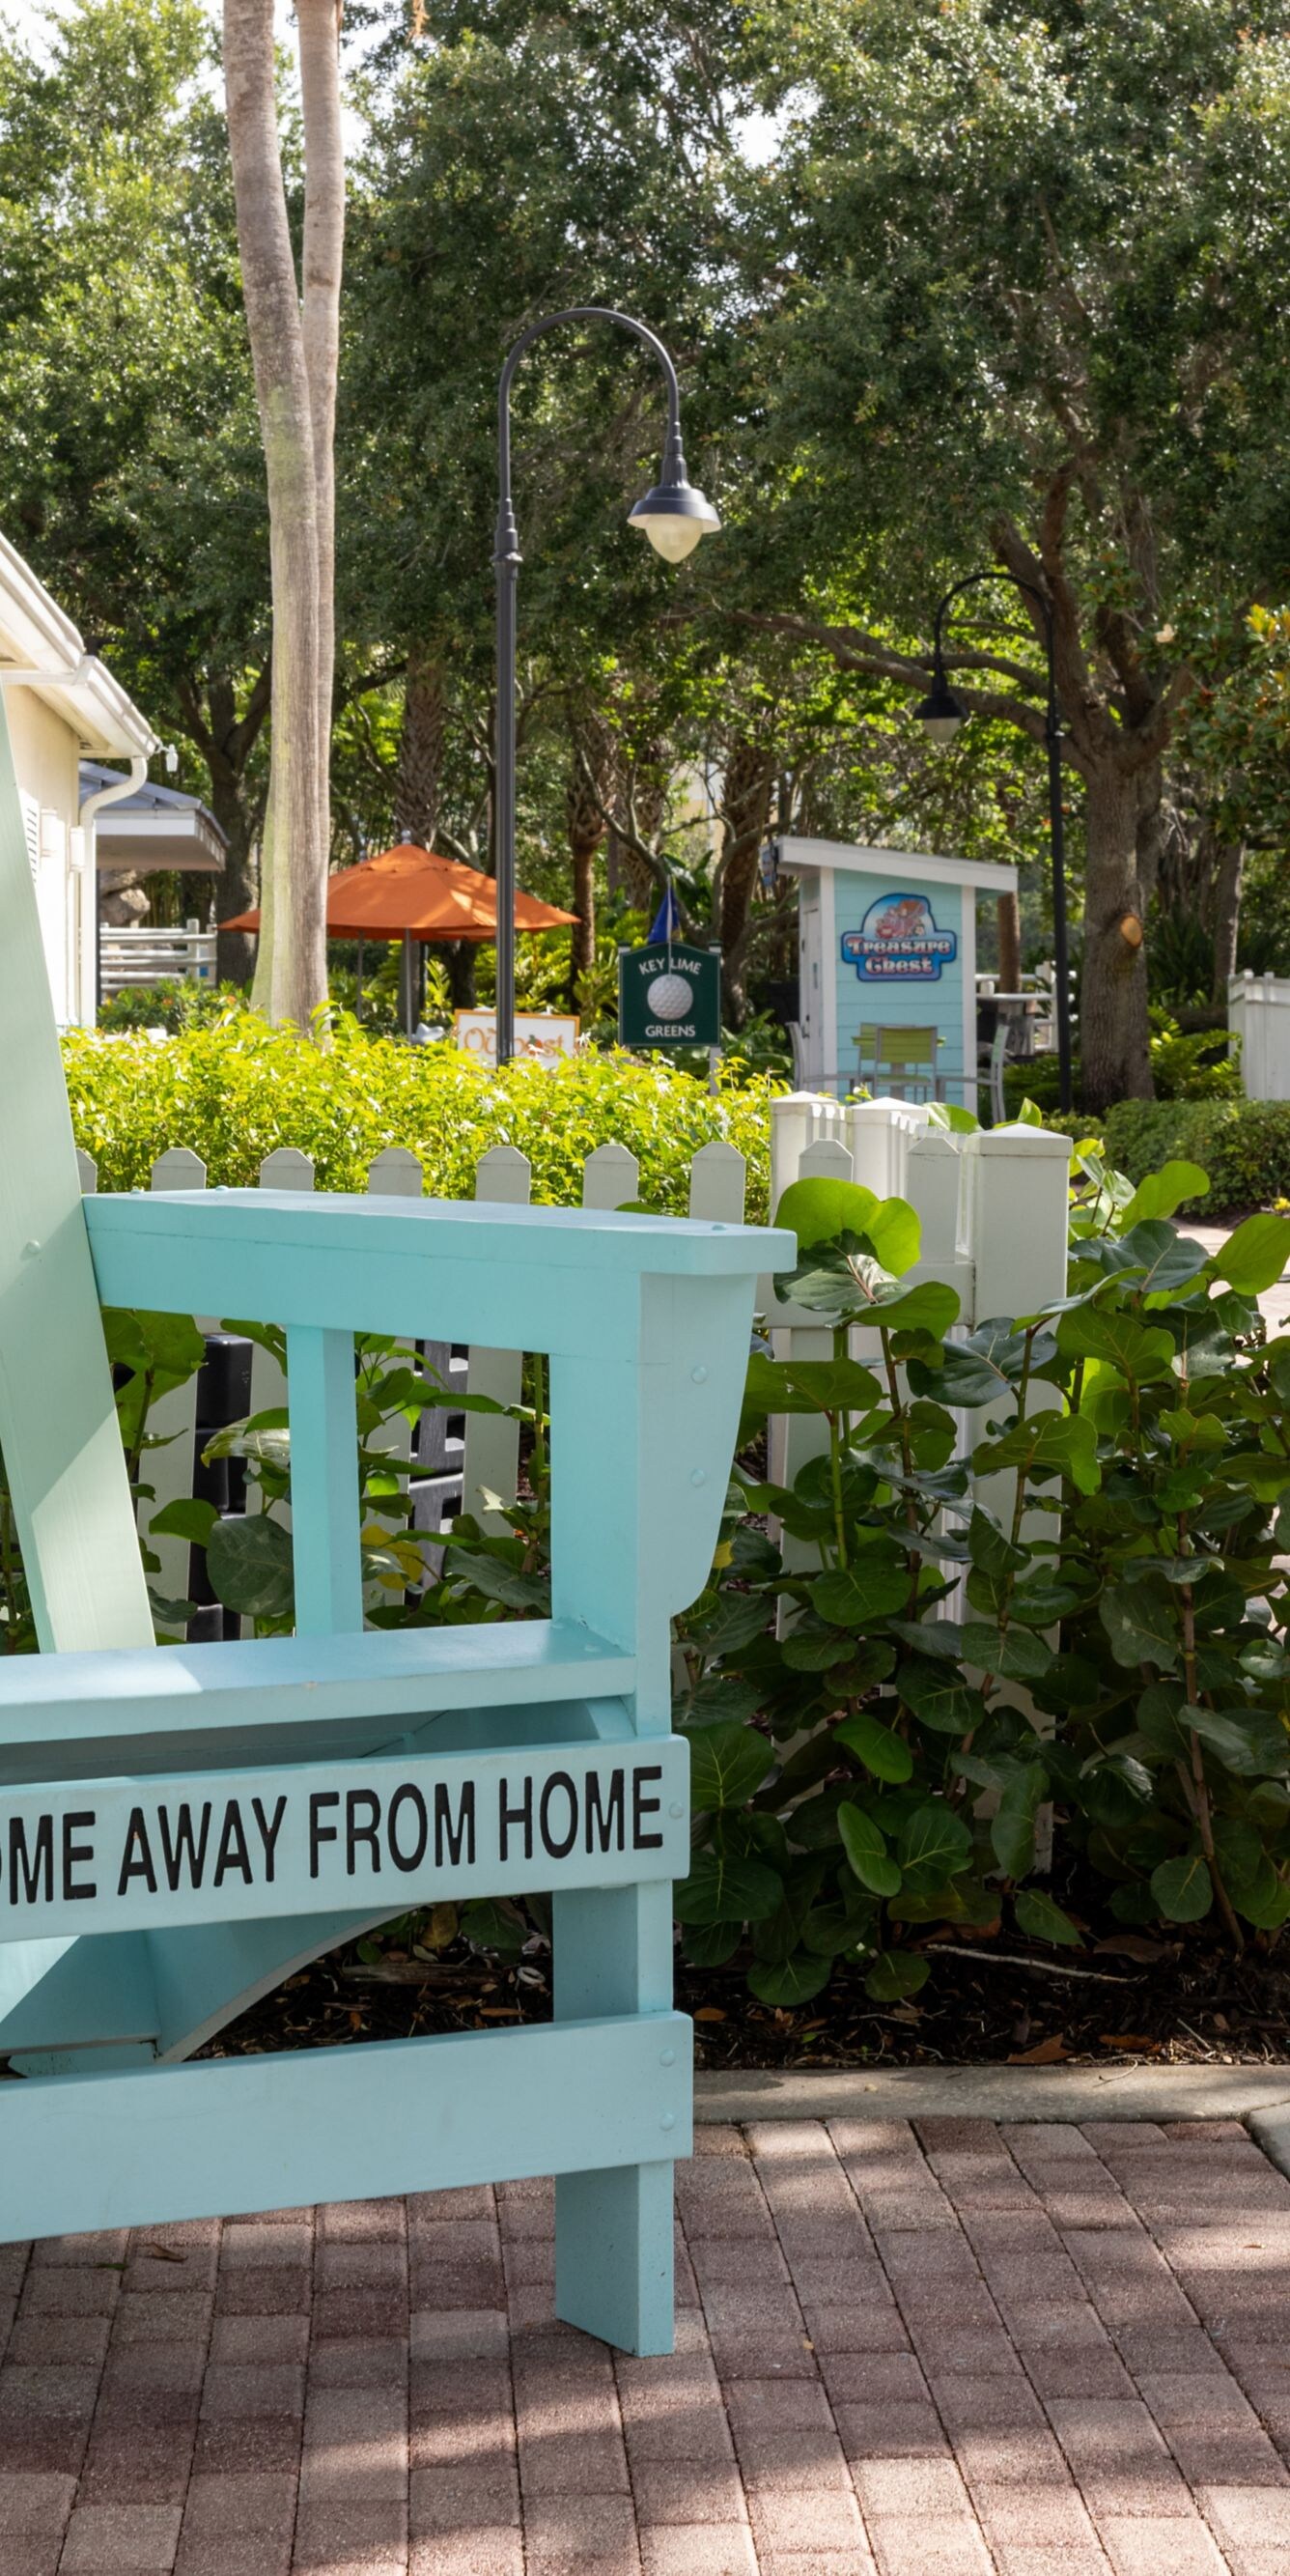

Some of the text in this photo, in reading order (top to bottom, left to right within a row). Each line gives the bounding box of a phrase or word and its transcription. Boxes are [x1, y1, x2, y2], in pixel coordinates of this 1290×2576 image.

[846, 936, 951, 955] Treasure
[638, 957, 702, 976] KEY LIME
[865, 956, 933, 975] Chest
[645, 1025, 696, 1038] GREENS
[0, 1766, 664, 1906] ME AWAY FROM HOME
